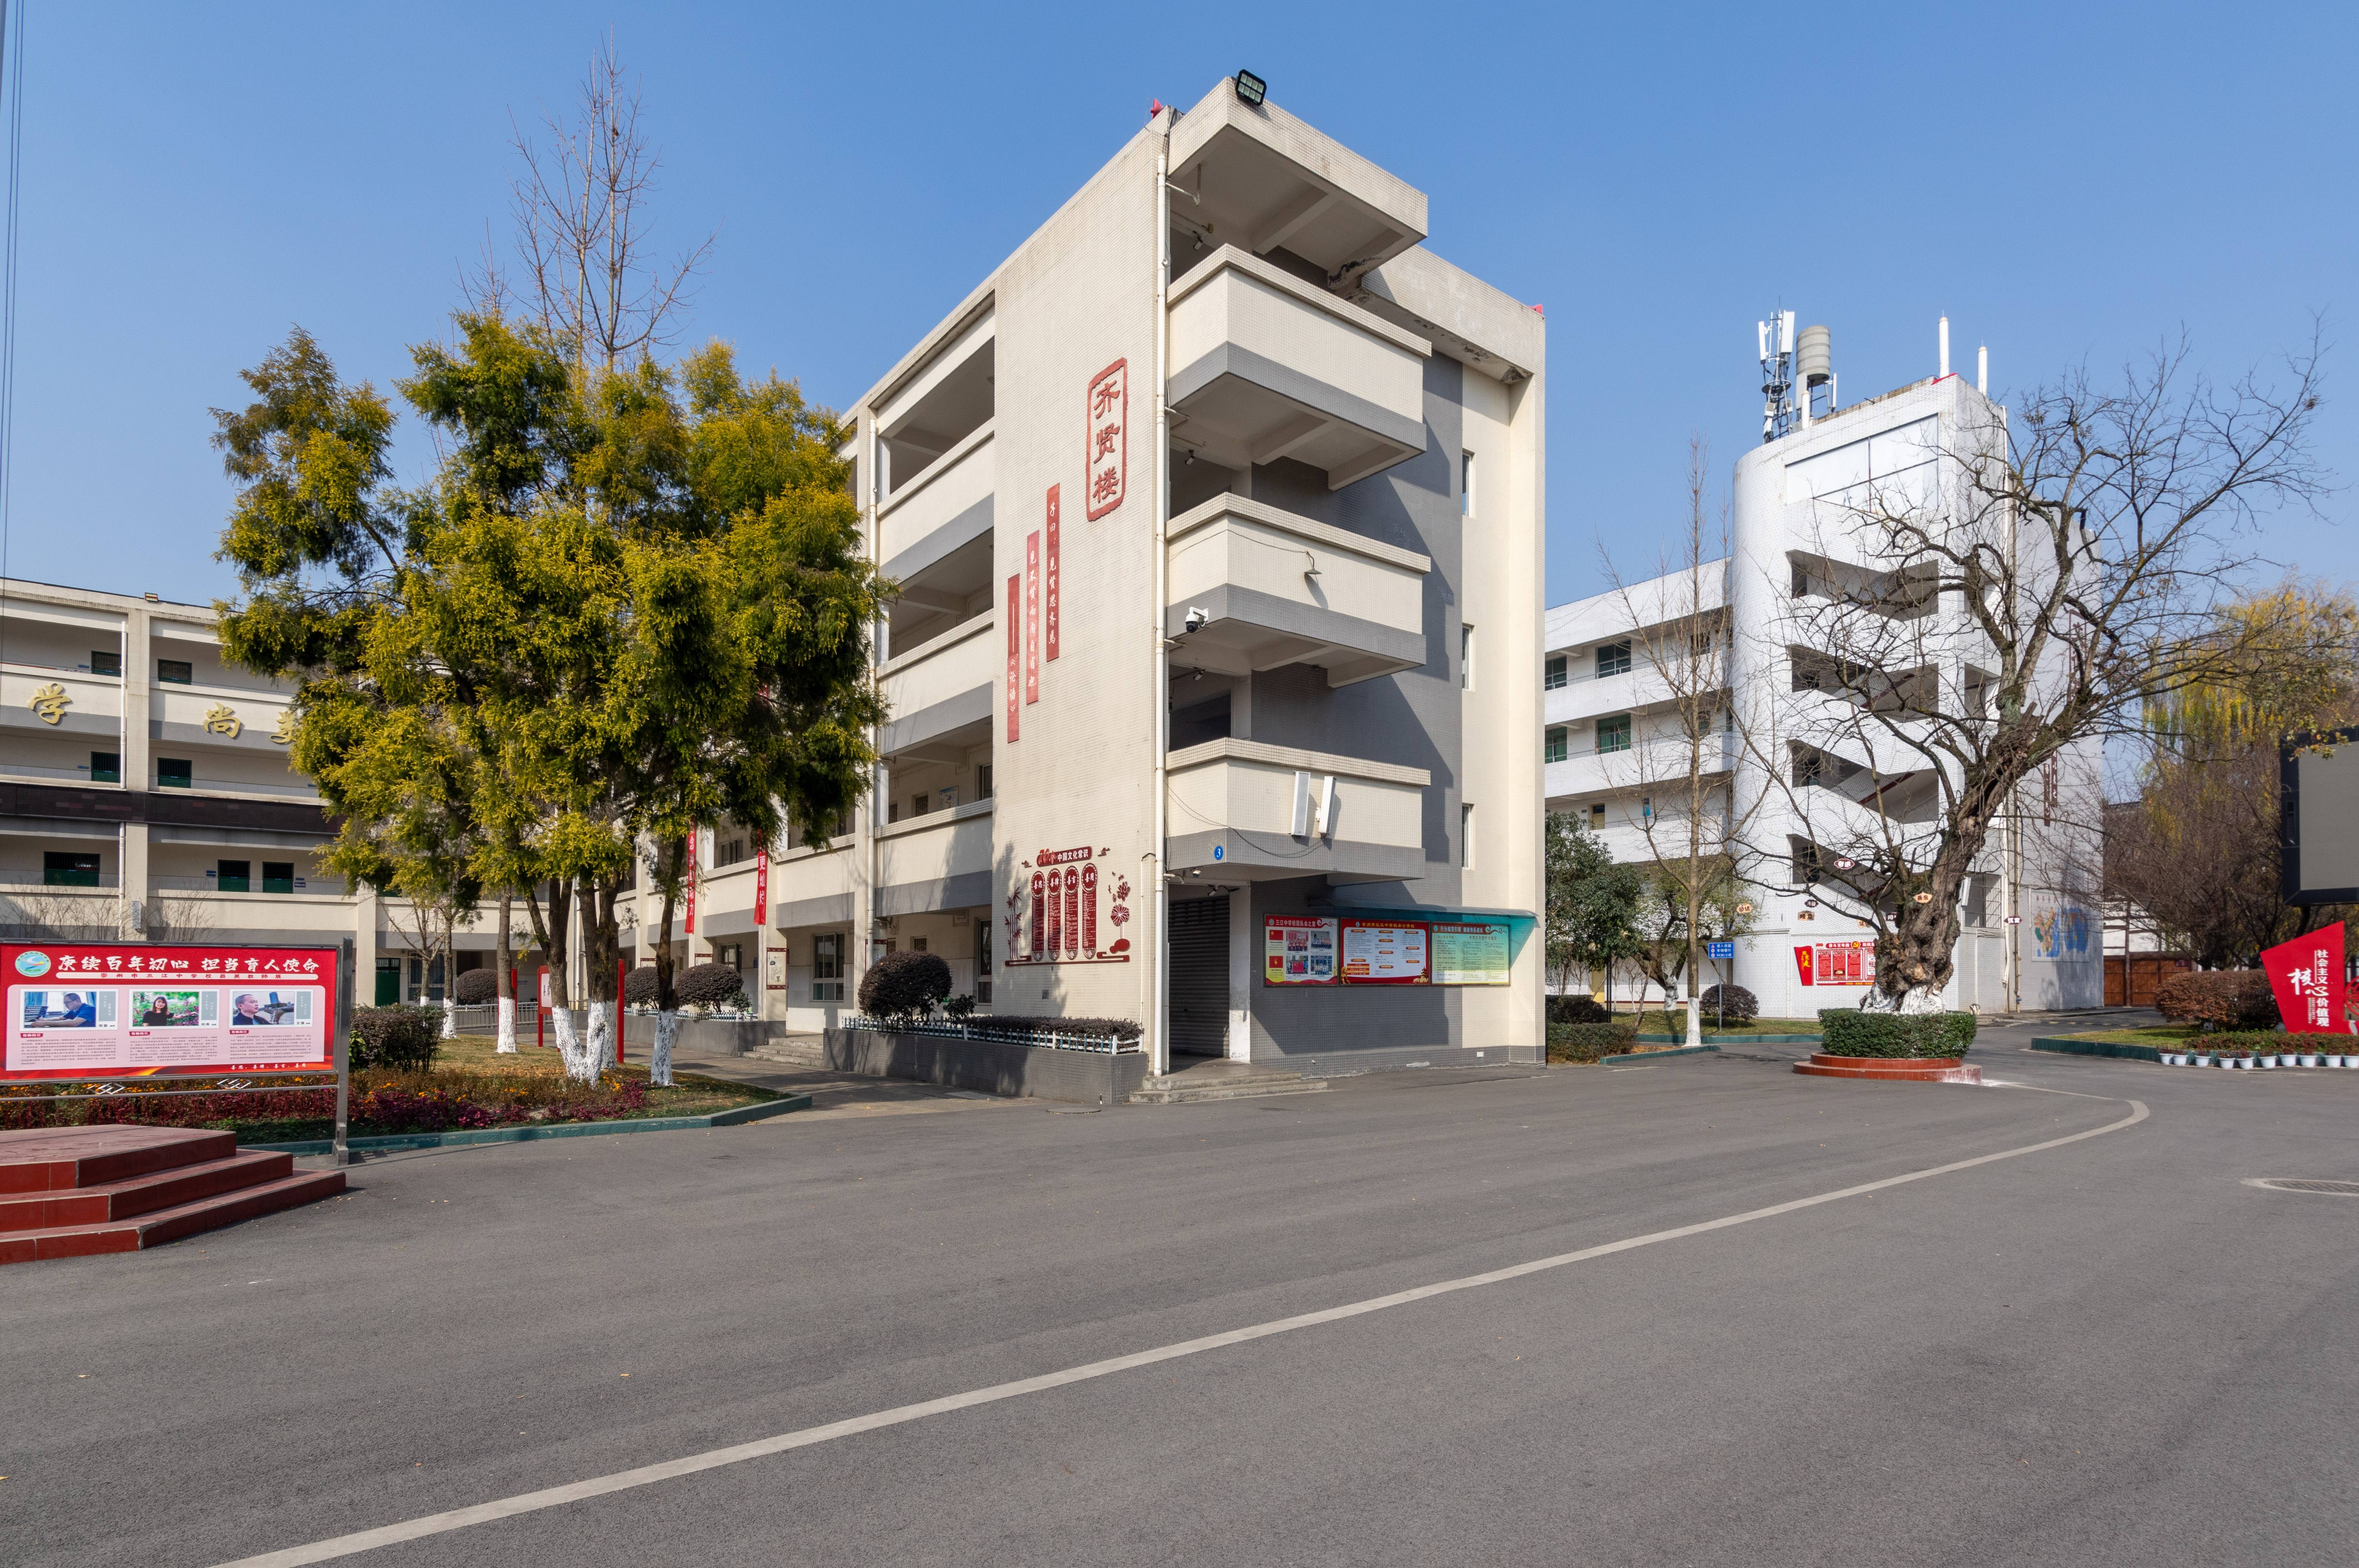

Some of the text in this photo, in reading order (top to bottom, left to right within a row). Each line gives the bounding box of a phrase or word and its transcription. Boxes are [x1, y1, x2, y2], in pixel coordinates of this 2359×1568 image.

[1093, 380, 1120, 503] 齐贤楼
[1028, 550, 1037, 687] 见不贤而内自省也
[1216, 848, 1221, 857] 3
[1034, 880, 1043, 889] 善思
[1067, 875, 1076, 885] 善言
[1085, 872, 1094, 882] 善用
[201, 958, 319, 973] 担当育人使命
[2317, 950, 2328, 984] 社会主义
[2287, 968, 2329, 997] 核心
[2316, 998, 2329, 1027] 价值观
